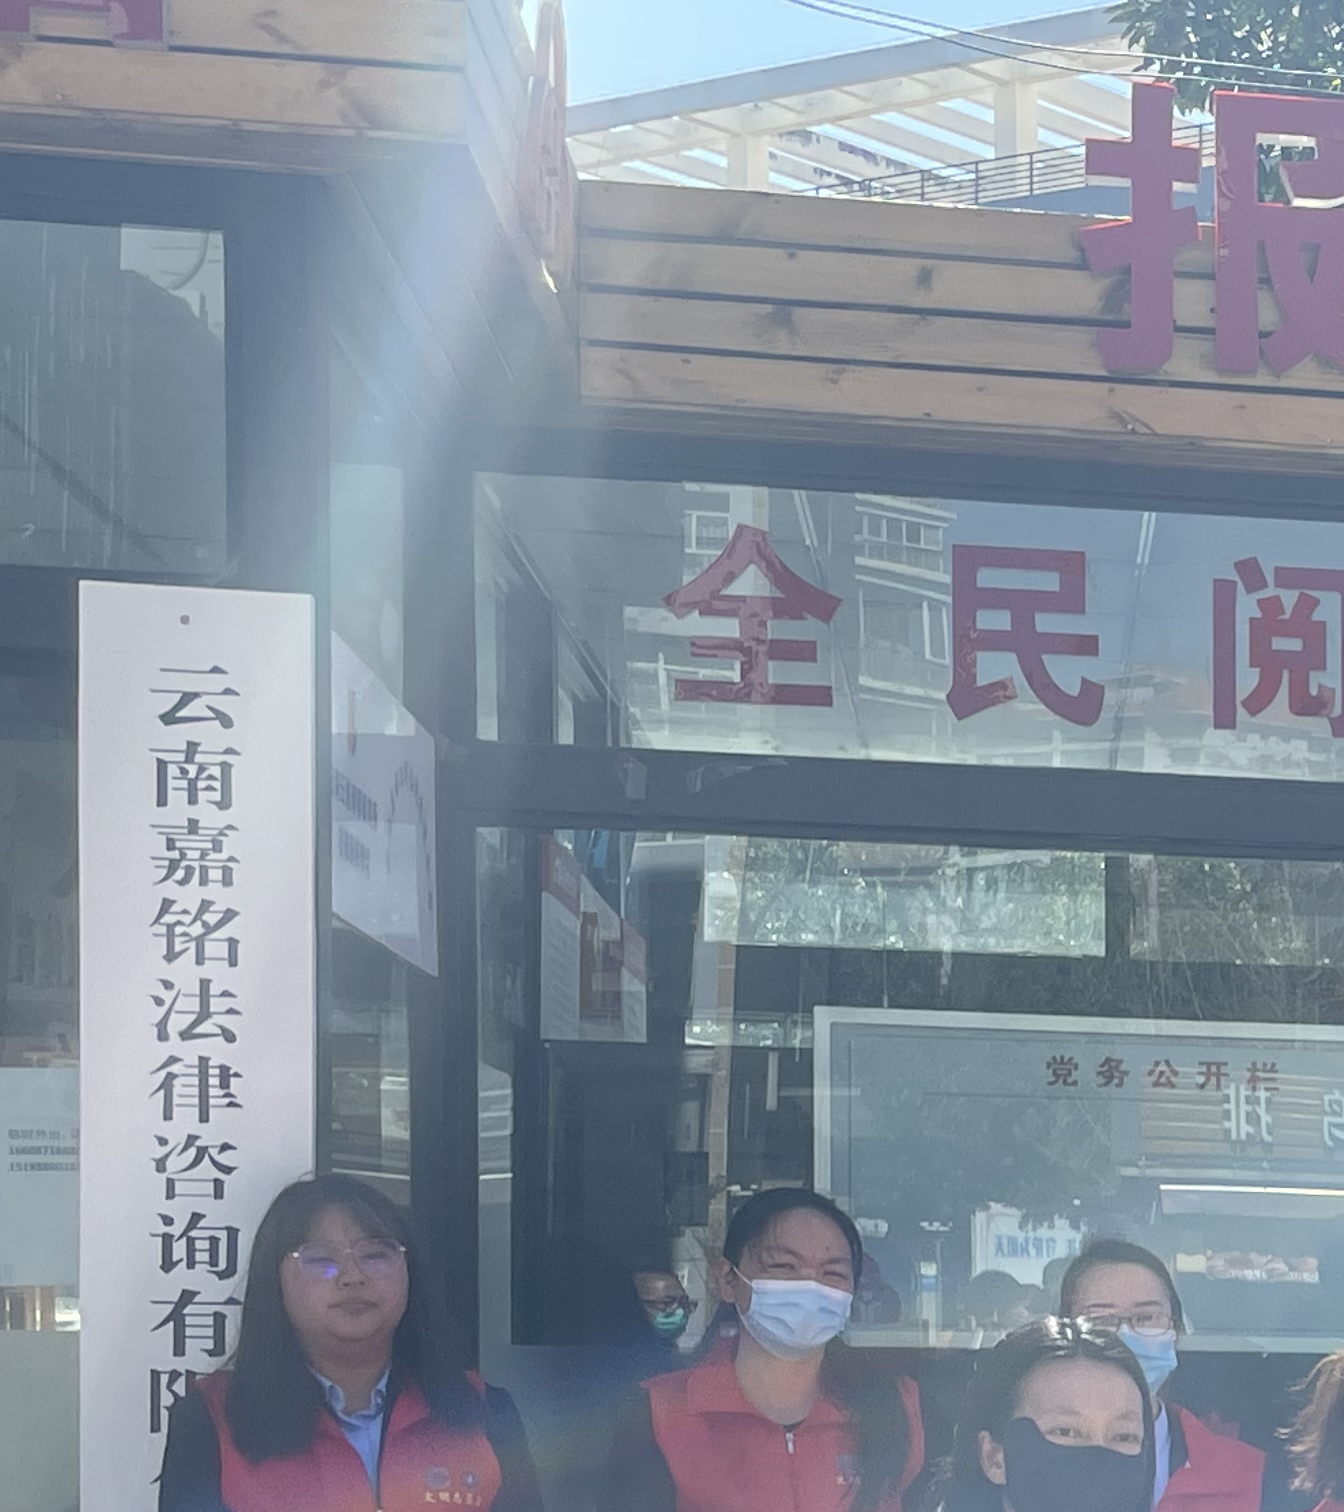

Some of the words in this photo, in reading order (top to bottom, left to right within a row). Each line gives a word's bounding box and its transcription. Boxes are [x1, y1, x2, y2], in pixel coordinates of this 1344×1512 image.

[1045, 1054, 1281, 1094] 党务公开栏
